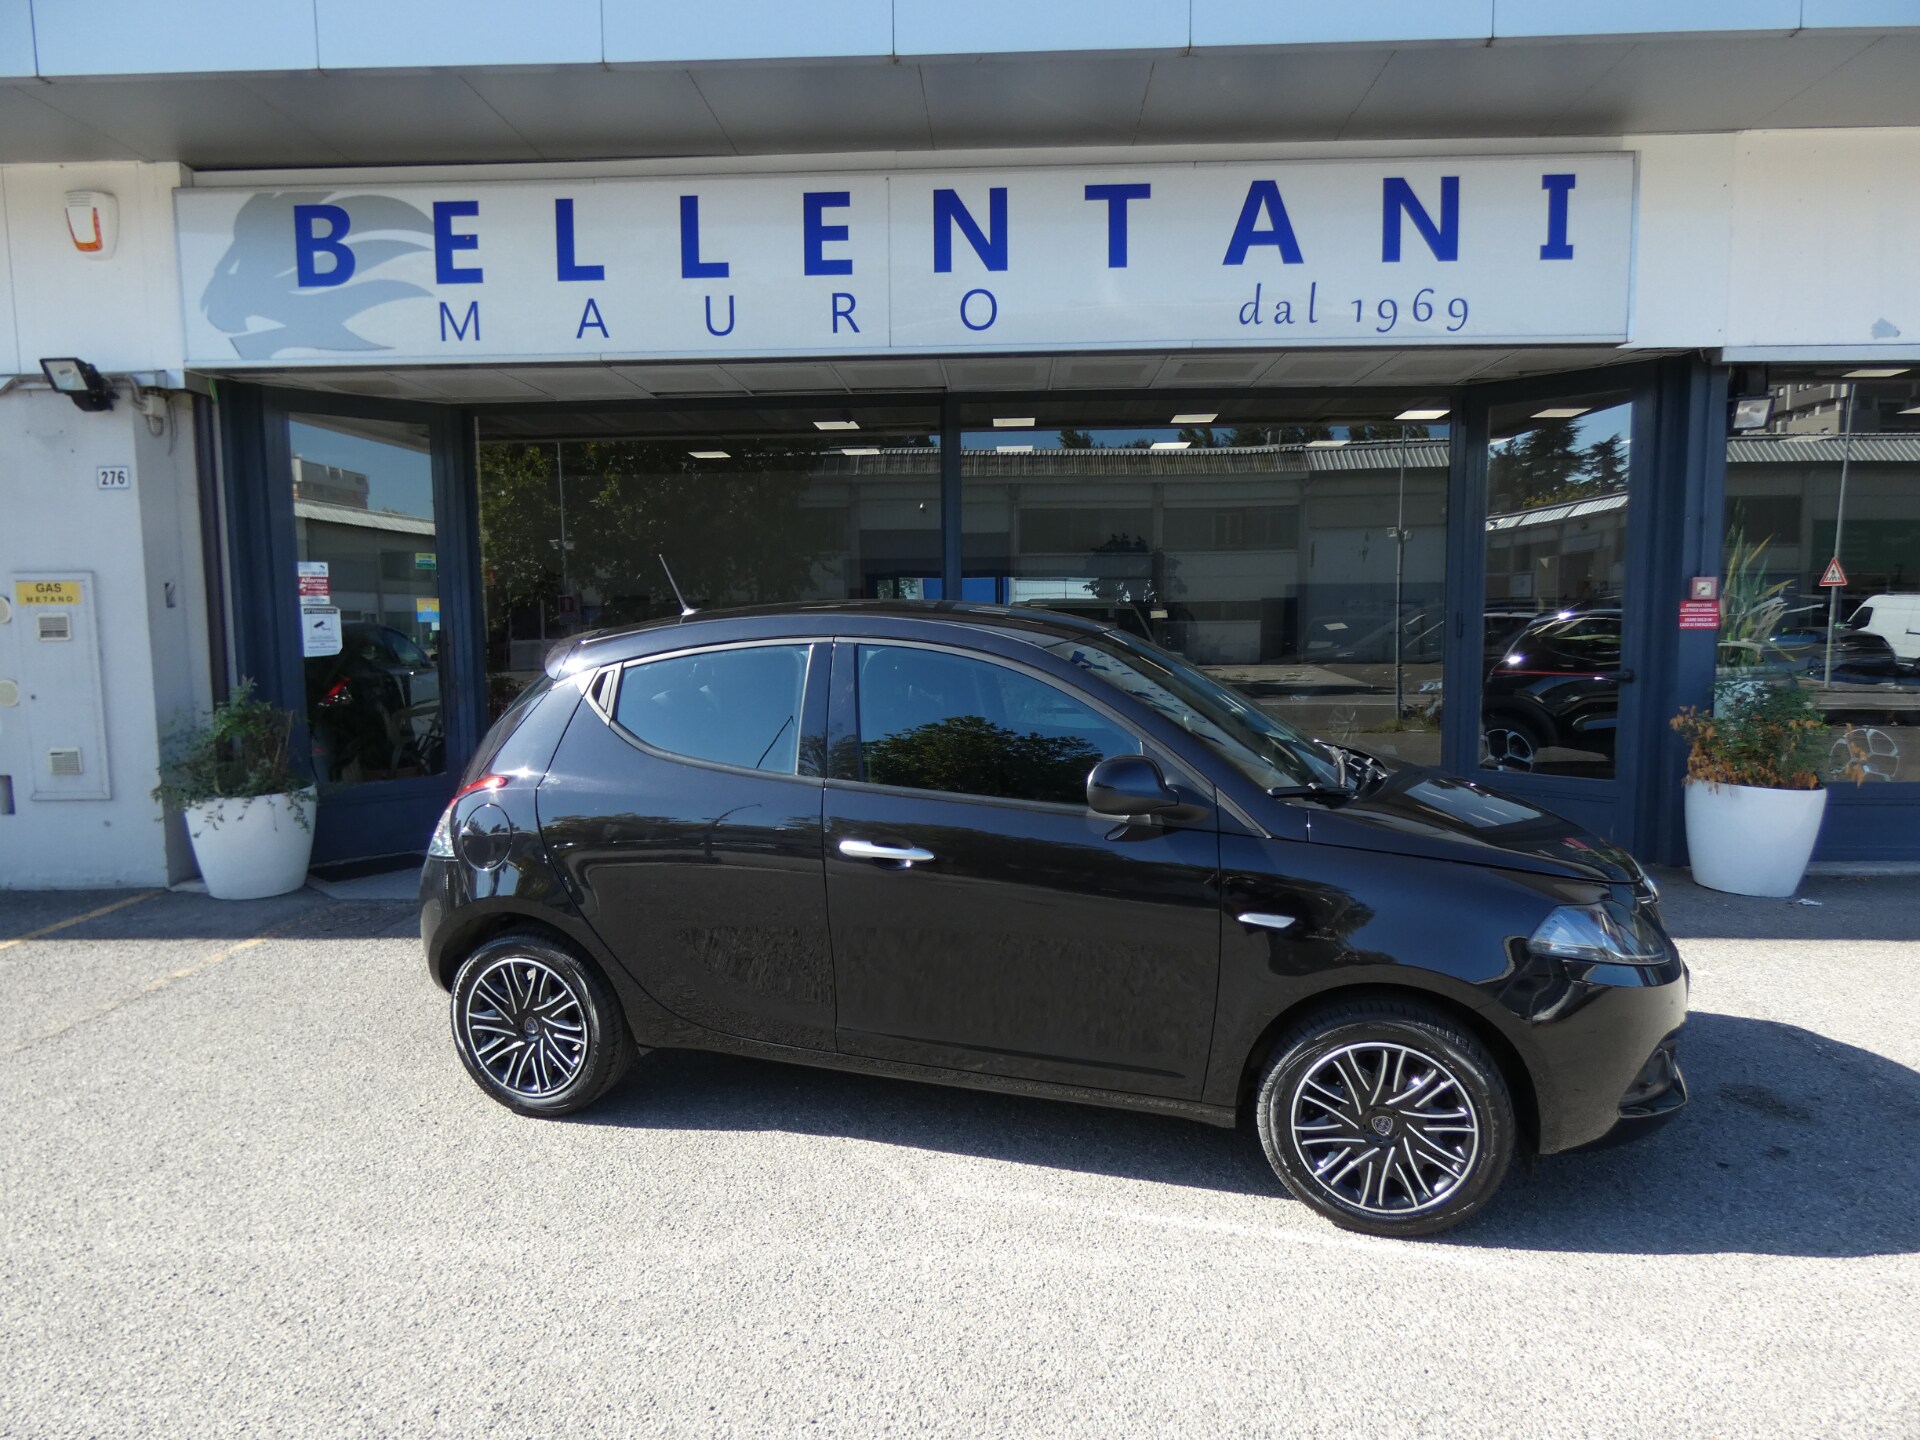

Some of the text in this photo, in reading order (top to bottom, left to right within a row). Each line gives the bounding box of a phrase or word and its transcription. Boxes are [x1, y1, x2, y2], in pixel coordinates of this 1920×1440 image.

[294, 173, 1576, 287] BELLENTANI
[438, 288, 998, 342] MAURO
[1239, 281, 1470, 334] dal 1969
[101, 470, 125, 485] 276
[35, 583, 62, 593] GAS
